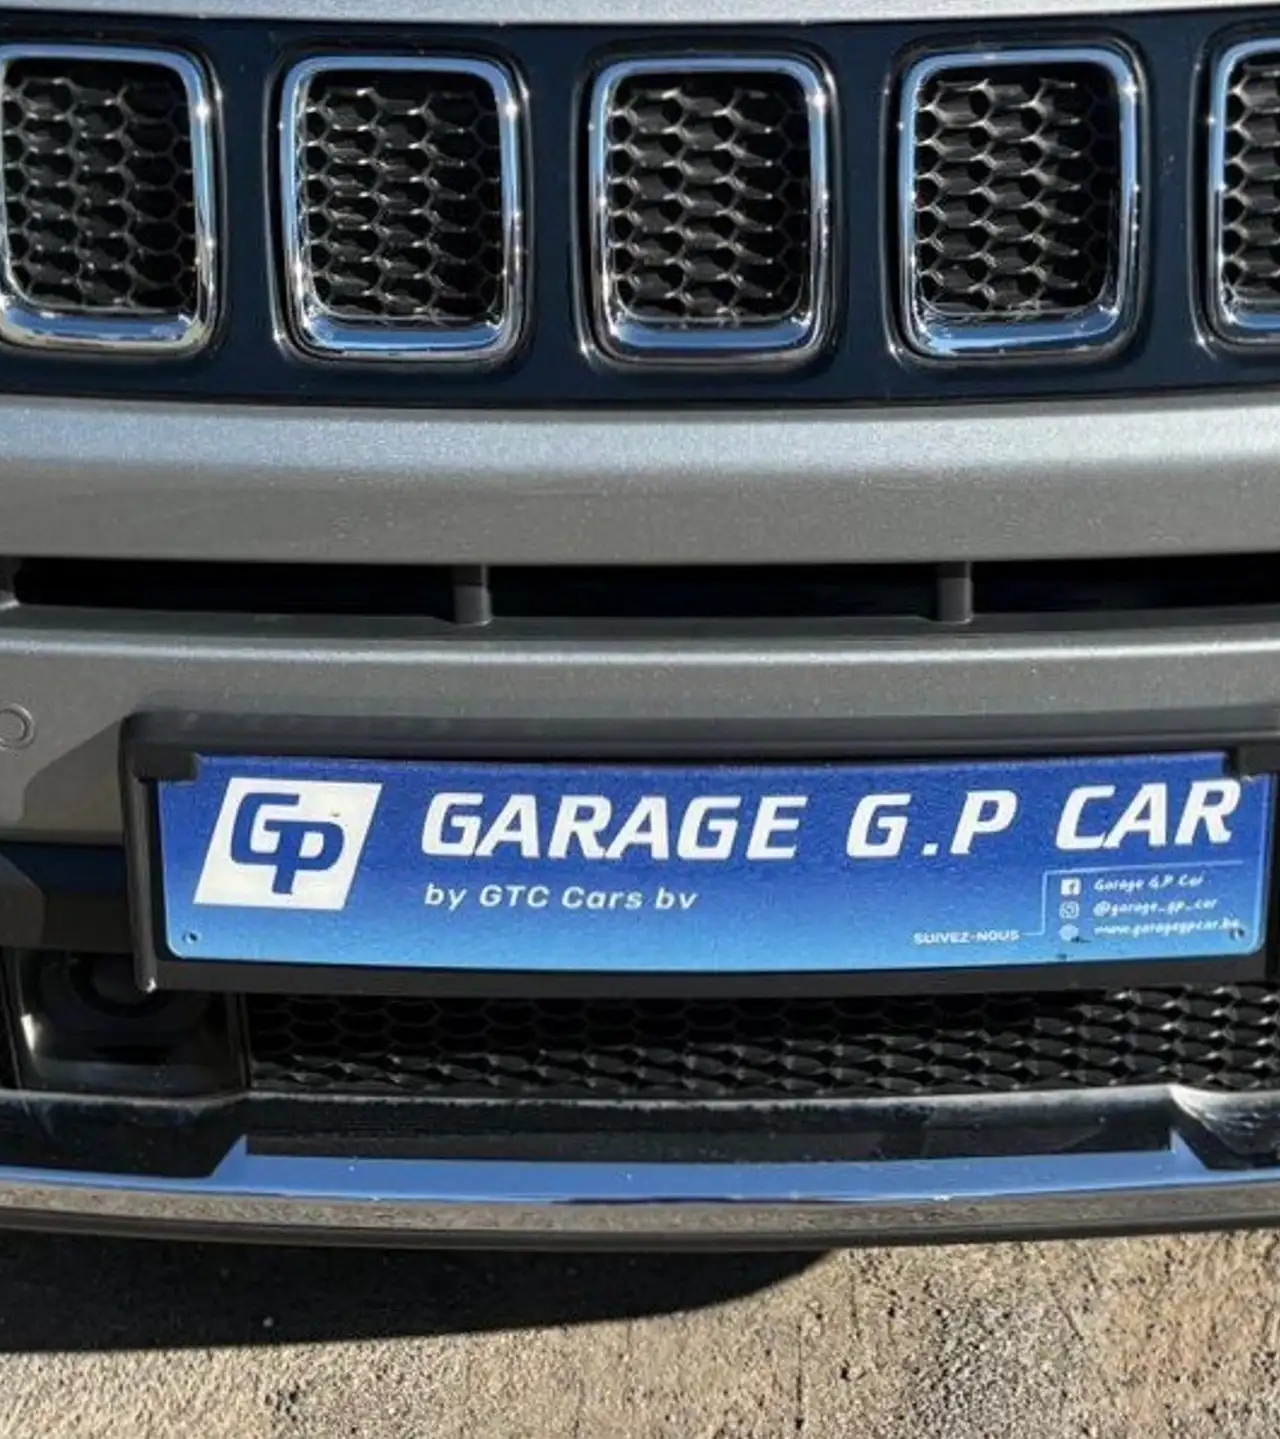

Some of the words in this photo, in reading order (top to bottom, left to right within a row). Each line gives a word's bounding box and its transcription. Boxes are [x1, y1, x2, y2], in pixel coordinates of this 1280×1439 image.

[421, 791, 806, 860] GARAGE
[846, 789, 1017, 858] G.P
[1056, 778, 1241, 851] CAR
[424, 883, 466, 913] by
[478, 885, 550, 908] GTC
[561, 885, 643, 910] Cars
[655, 886, 698, 910] bv
[913, 929, 1020, 946] SUIVEZ-NOUS
